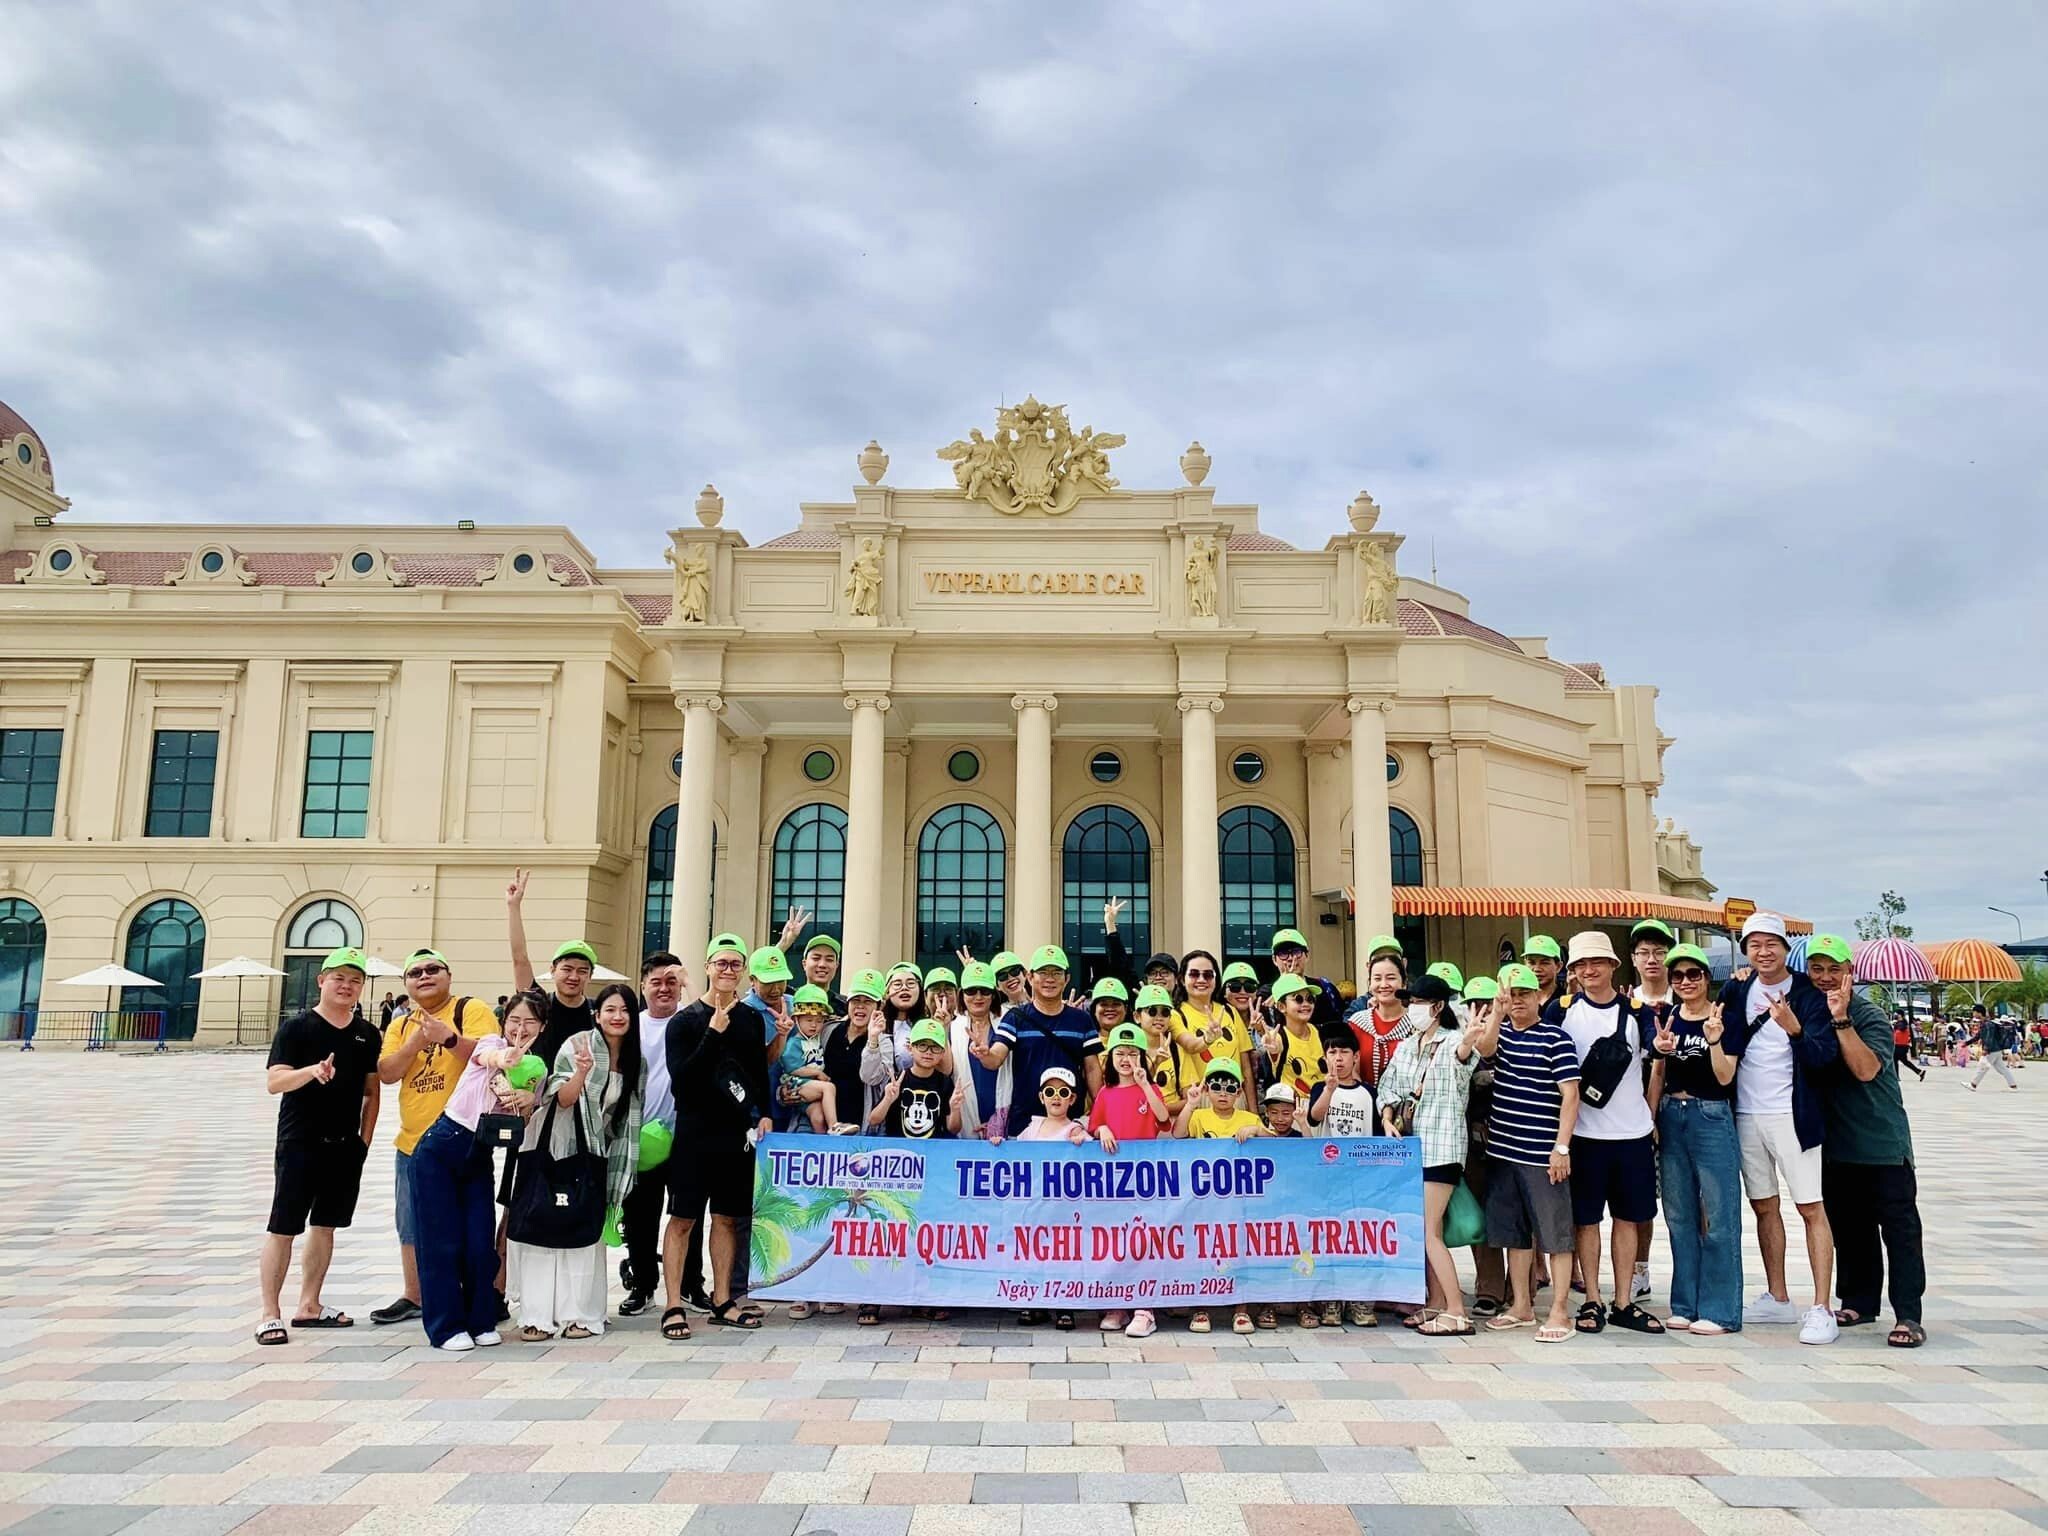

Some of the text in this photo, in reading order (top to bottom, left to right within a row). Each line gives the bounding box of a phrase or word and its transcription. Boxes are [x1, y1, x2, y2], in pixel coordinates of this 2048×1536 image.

[923, 571, 1146, 595] VINPEARL CABLE CAR
[956, 1158, 1275, 1199] TECH HORIZON CORP
[832, 1221, 907, 1258] THAM
[916, 1223, 988, 1265] QUAN
[1014, 1212, 1082, 1261] NGHỈ
[1091, 1216, 1185, 1262] DƯỠNG
[1194, 1223, 1238, 1266] TẠI
[1245, 1221, 1300, 1256] NHA
[1308, 1220, 1398, 1255] TRANG
[997, 1277, 1234, 1301] Ngày 17-20 tháng 07 năm 2024
